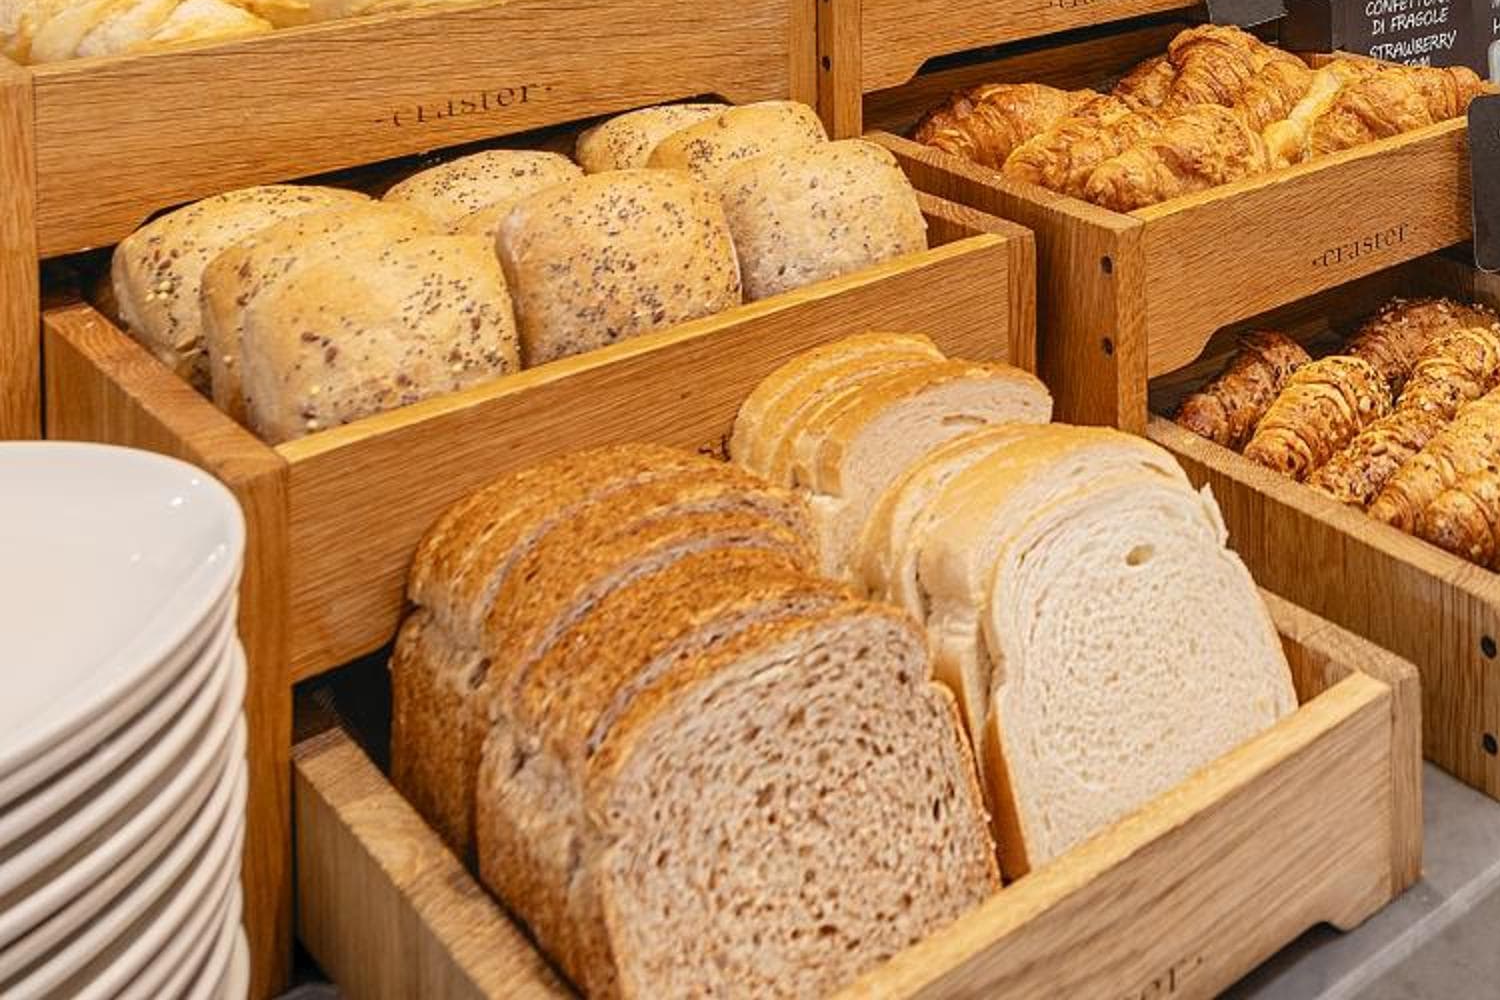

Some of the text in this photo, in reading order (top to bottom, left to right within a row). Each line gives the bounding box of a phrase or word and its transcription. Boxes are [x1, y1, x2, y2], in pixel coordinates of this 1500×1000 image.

[1372, 7, 1449, 36] DI FRAGOLE
[1370, 29, 1457, 60] STRAWBERRY
